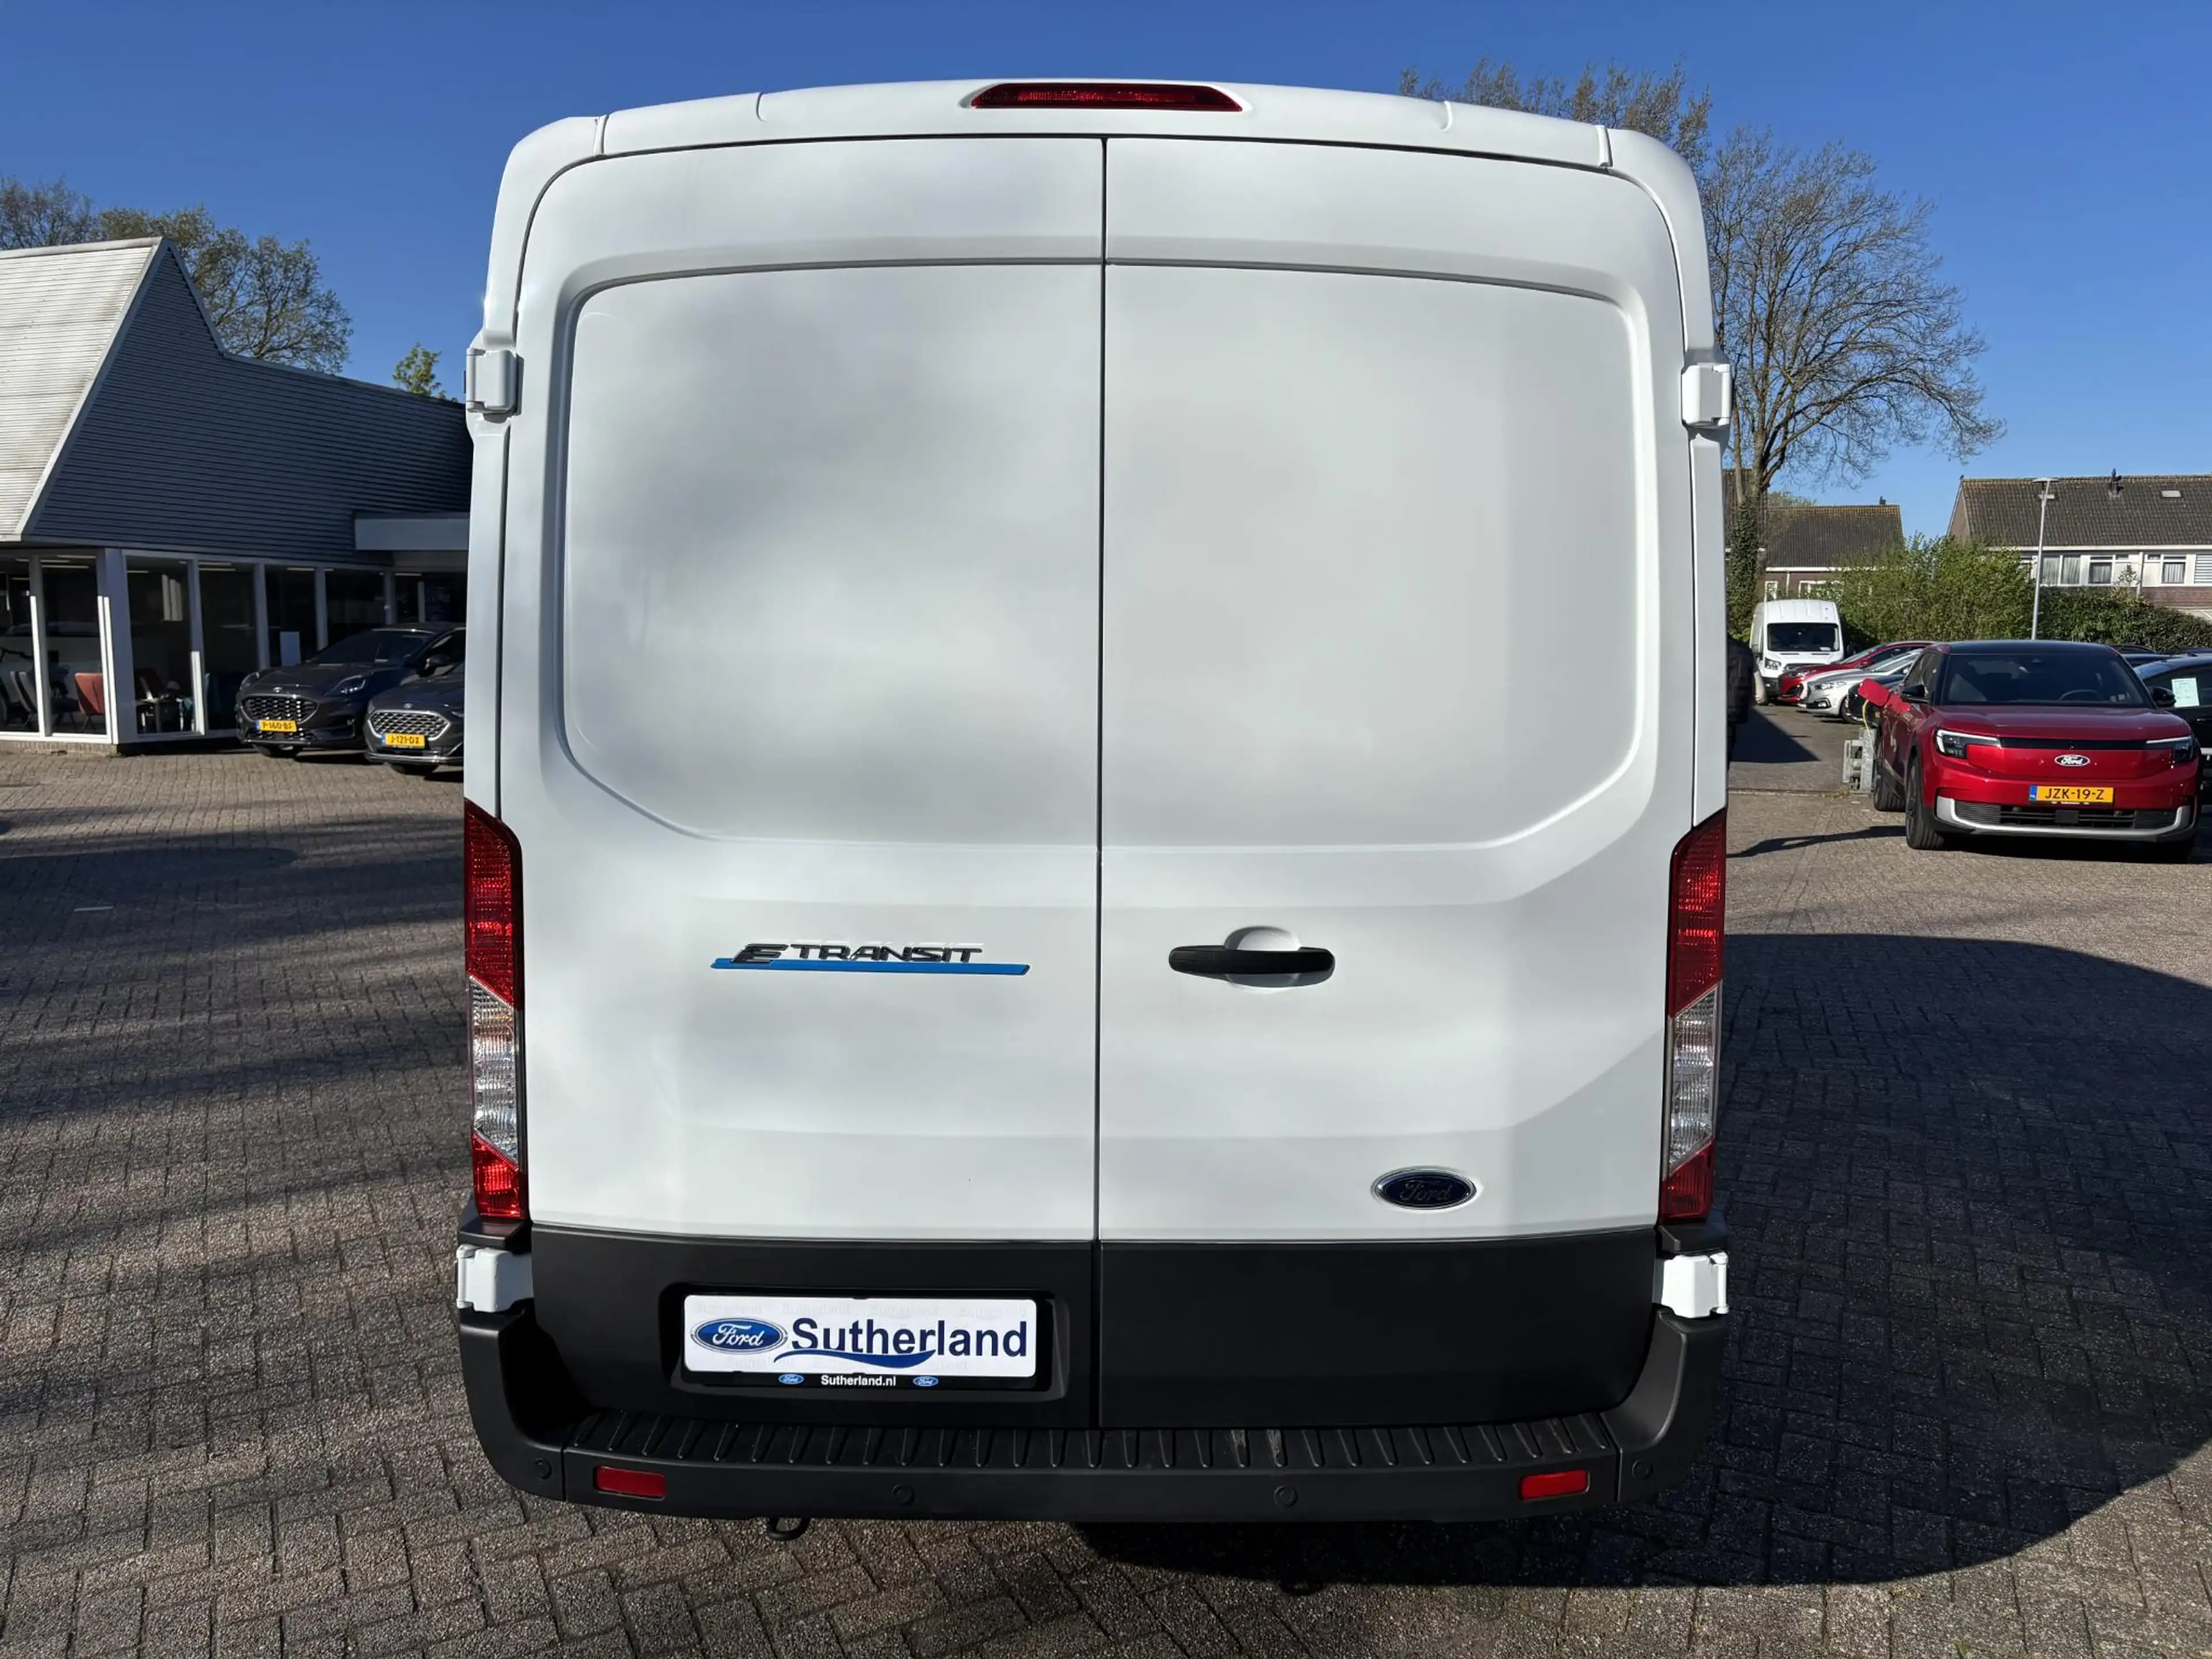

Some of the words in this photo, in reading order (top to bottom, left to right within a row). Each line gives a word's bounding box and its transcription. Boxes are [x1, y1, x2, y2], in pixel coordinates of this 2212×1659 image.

[2046, 788, 2104, 800] JZK-19-Z
[1399, 1179, 1453, 1201] Ford
[711, 1324, 764, 1347] Ford
[791, 1317, 1027, 1358] Sutherland
[821, 1374, 896, 1387] Sutherland.nl
